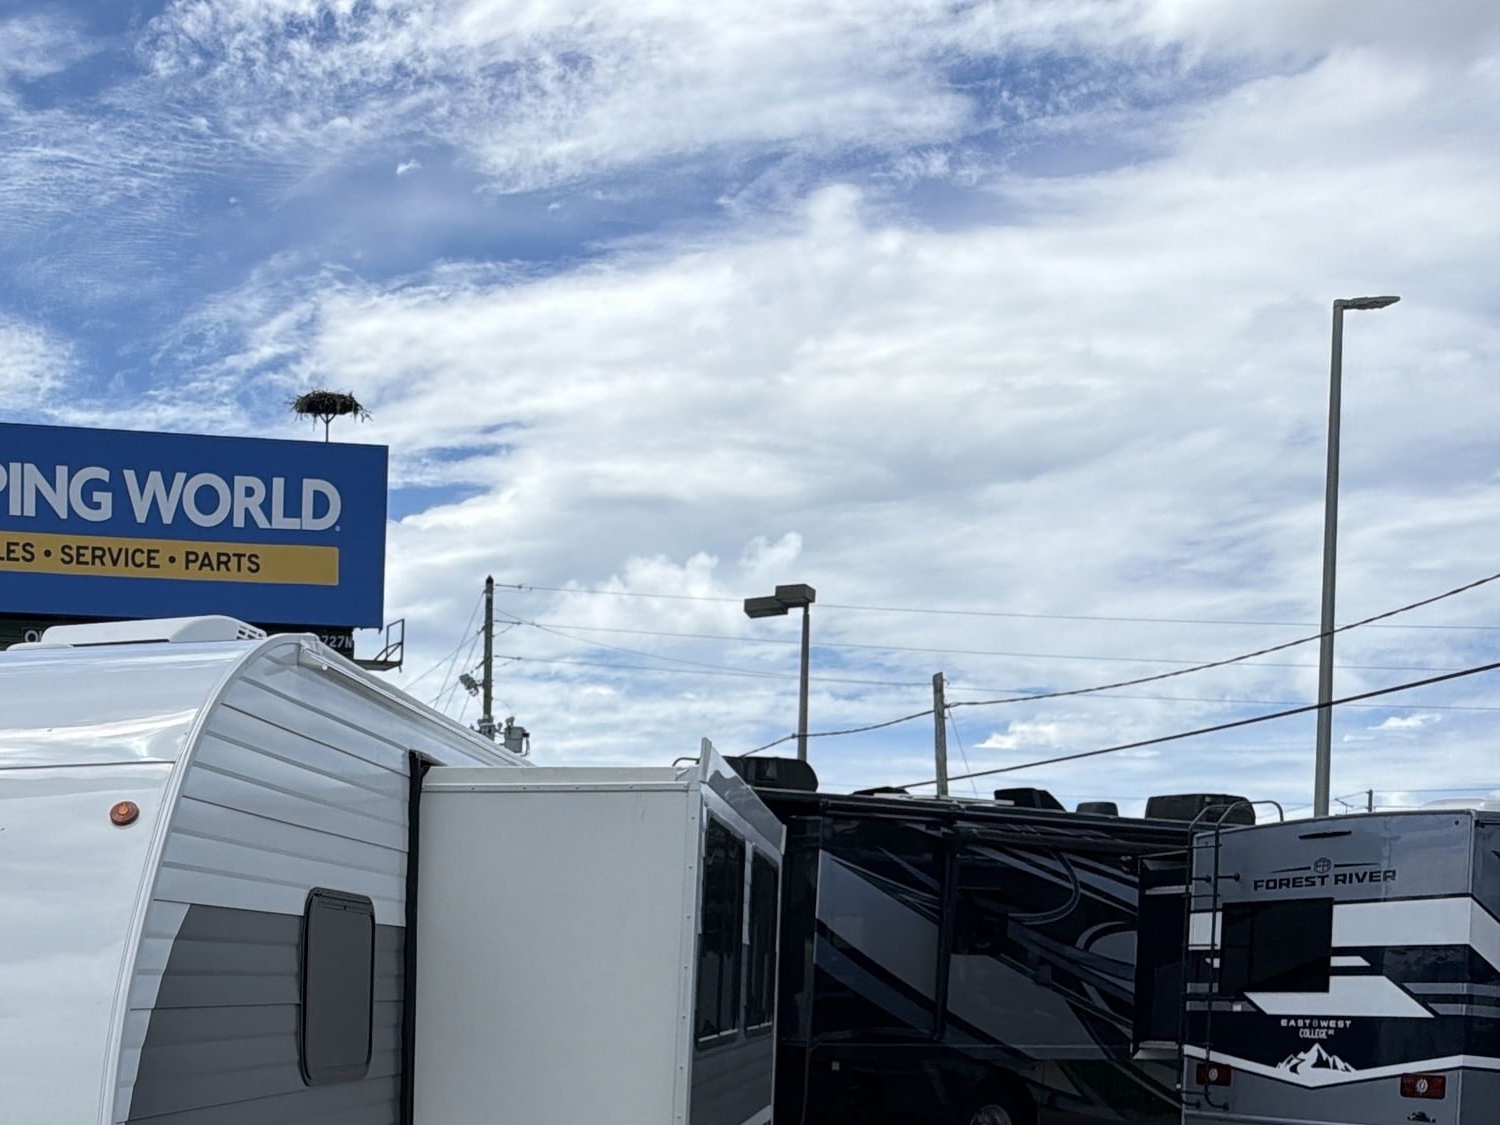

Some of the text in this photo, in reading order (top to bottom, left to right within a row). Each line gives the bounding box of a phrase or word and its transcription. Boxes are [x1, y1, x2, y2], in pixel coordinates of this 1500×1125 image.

[122, 469, 342, 532] WORLD
[59, 544, 160, 569] SERVICE
[184, 550, 260, 574] PARTS
[1253, 869, 1397, 891] FOREST RIVER
[1280, 1018, 1311, 1027] EAST
[1320, 1020, 1352, 1028] WEST
